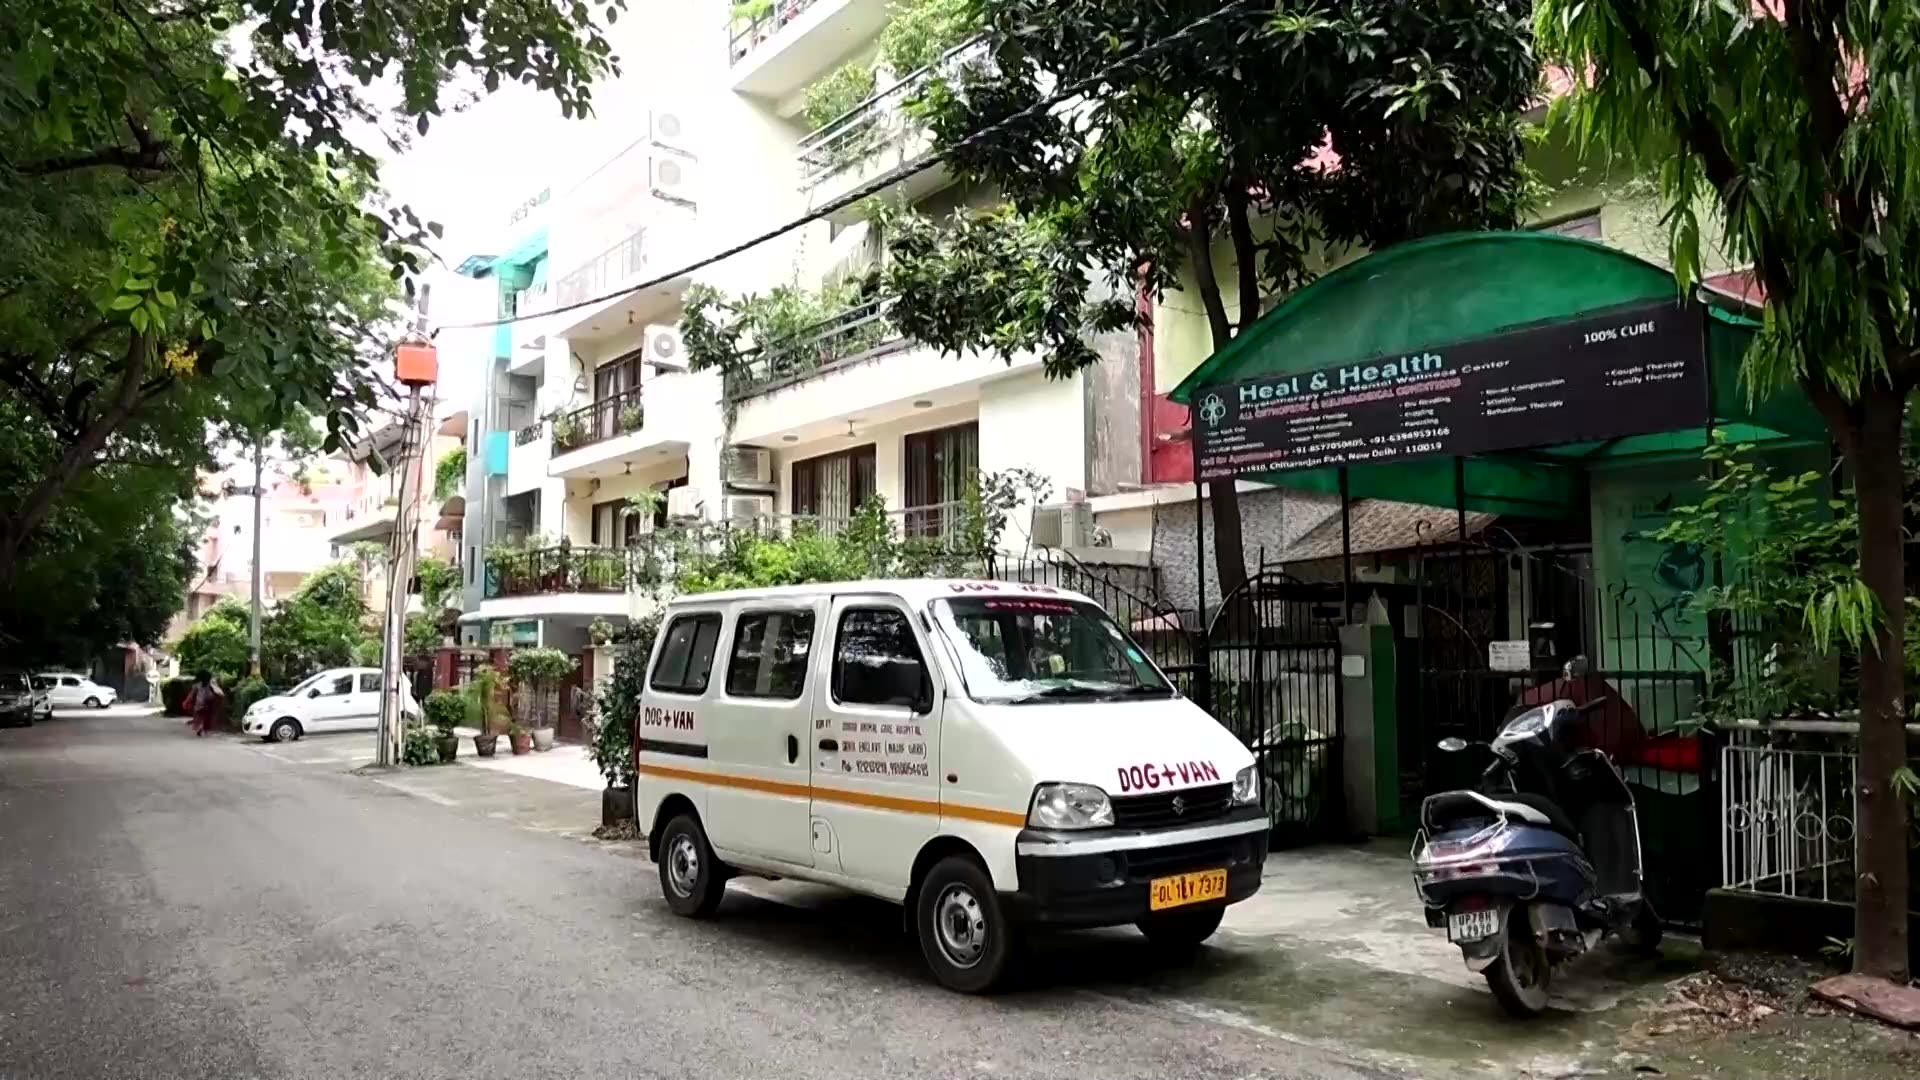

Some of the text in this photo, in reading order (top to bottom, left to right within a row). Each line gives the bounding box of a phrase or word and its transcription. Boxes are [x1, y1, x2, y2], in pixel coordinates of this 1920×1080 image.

[1584, 320, 1656, 344] 100% CURE
[1240, 352, 1442, 402] Heal & Health
[1611, 360, 1684, 377] Couple Therapy
[1612, 371, 1684, 387] Family Therapy
[1240, 359, 1510, 410] Physiotherapy and Mental Wellness Center
[1239, 412, 1254, 421] ALL
[1395, 377, 1461, 397] CONDITIONS
[1323, 453, 1346, 464] Park,
[1348, 451, 1370, 460] New
[1371, 446, 1397, 458] Delhi
[1405, 441, 1442, 454] 110019
[1198, 874, 1225, 896] 7373
